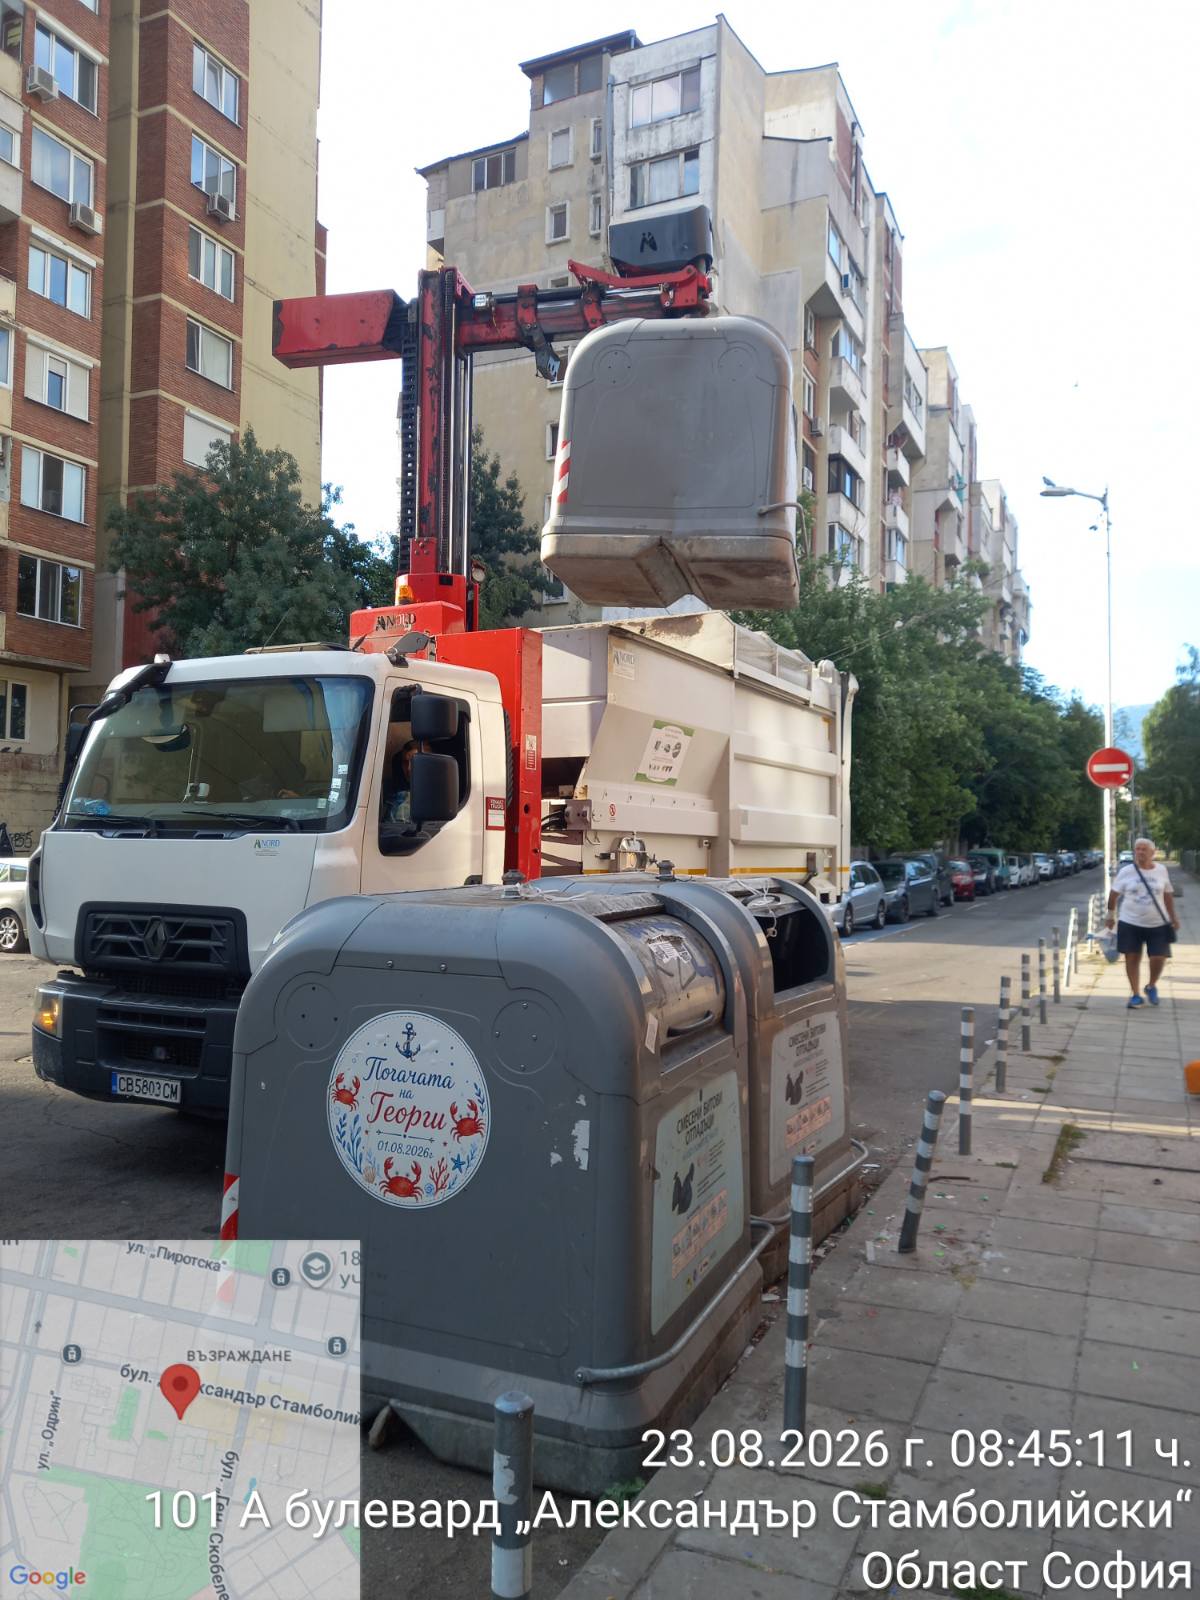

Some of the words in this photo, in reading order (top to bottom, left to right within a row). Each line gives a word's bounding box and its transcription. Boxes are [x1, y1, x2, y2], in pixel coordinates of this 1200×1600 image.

[363, 1056, 455, 1089] Погачата
[399, 1088, 414, 1100] на
[366, 1091, 447, 1134] Георги
